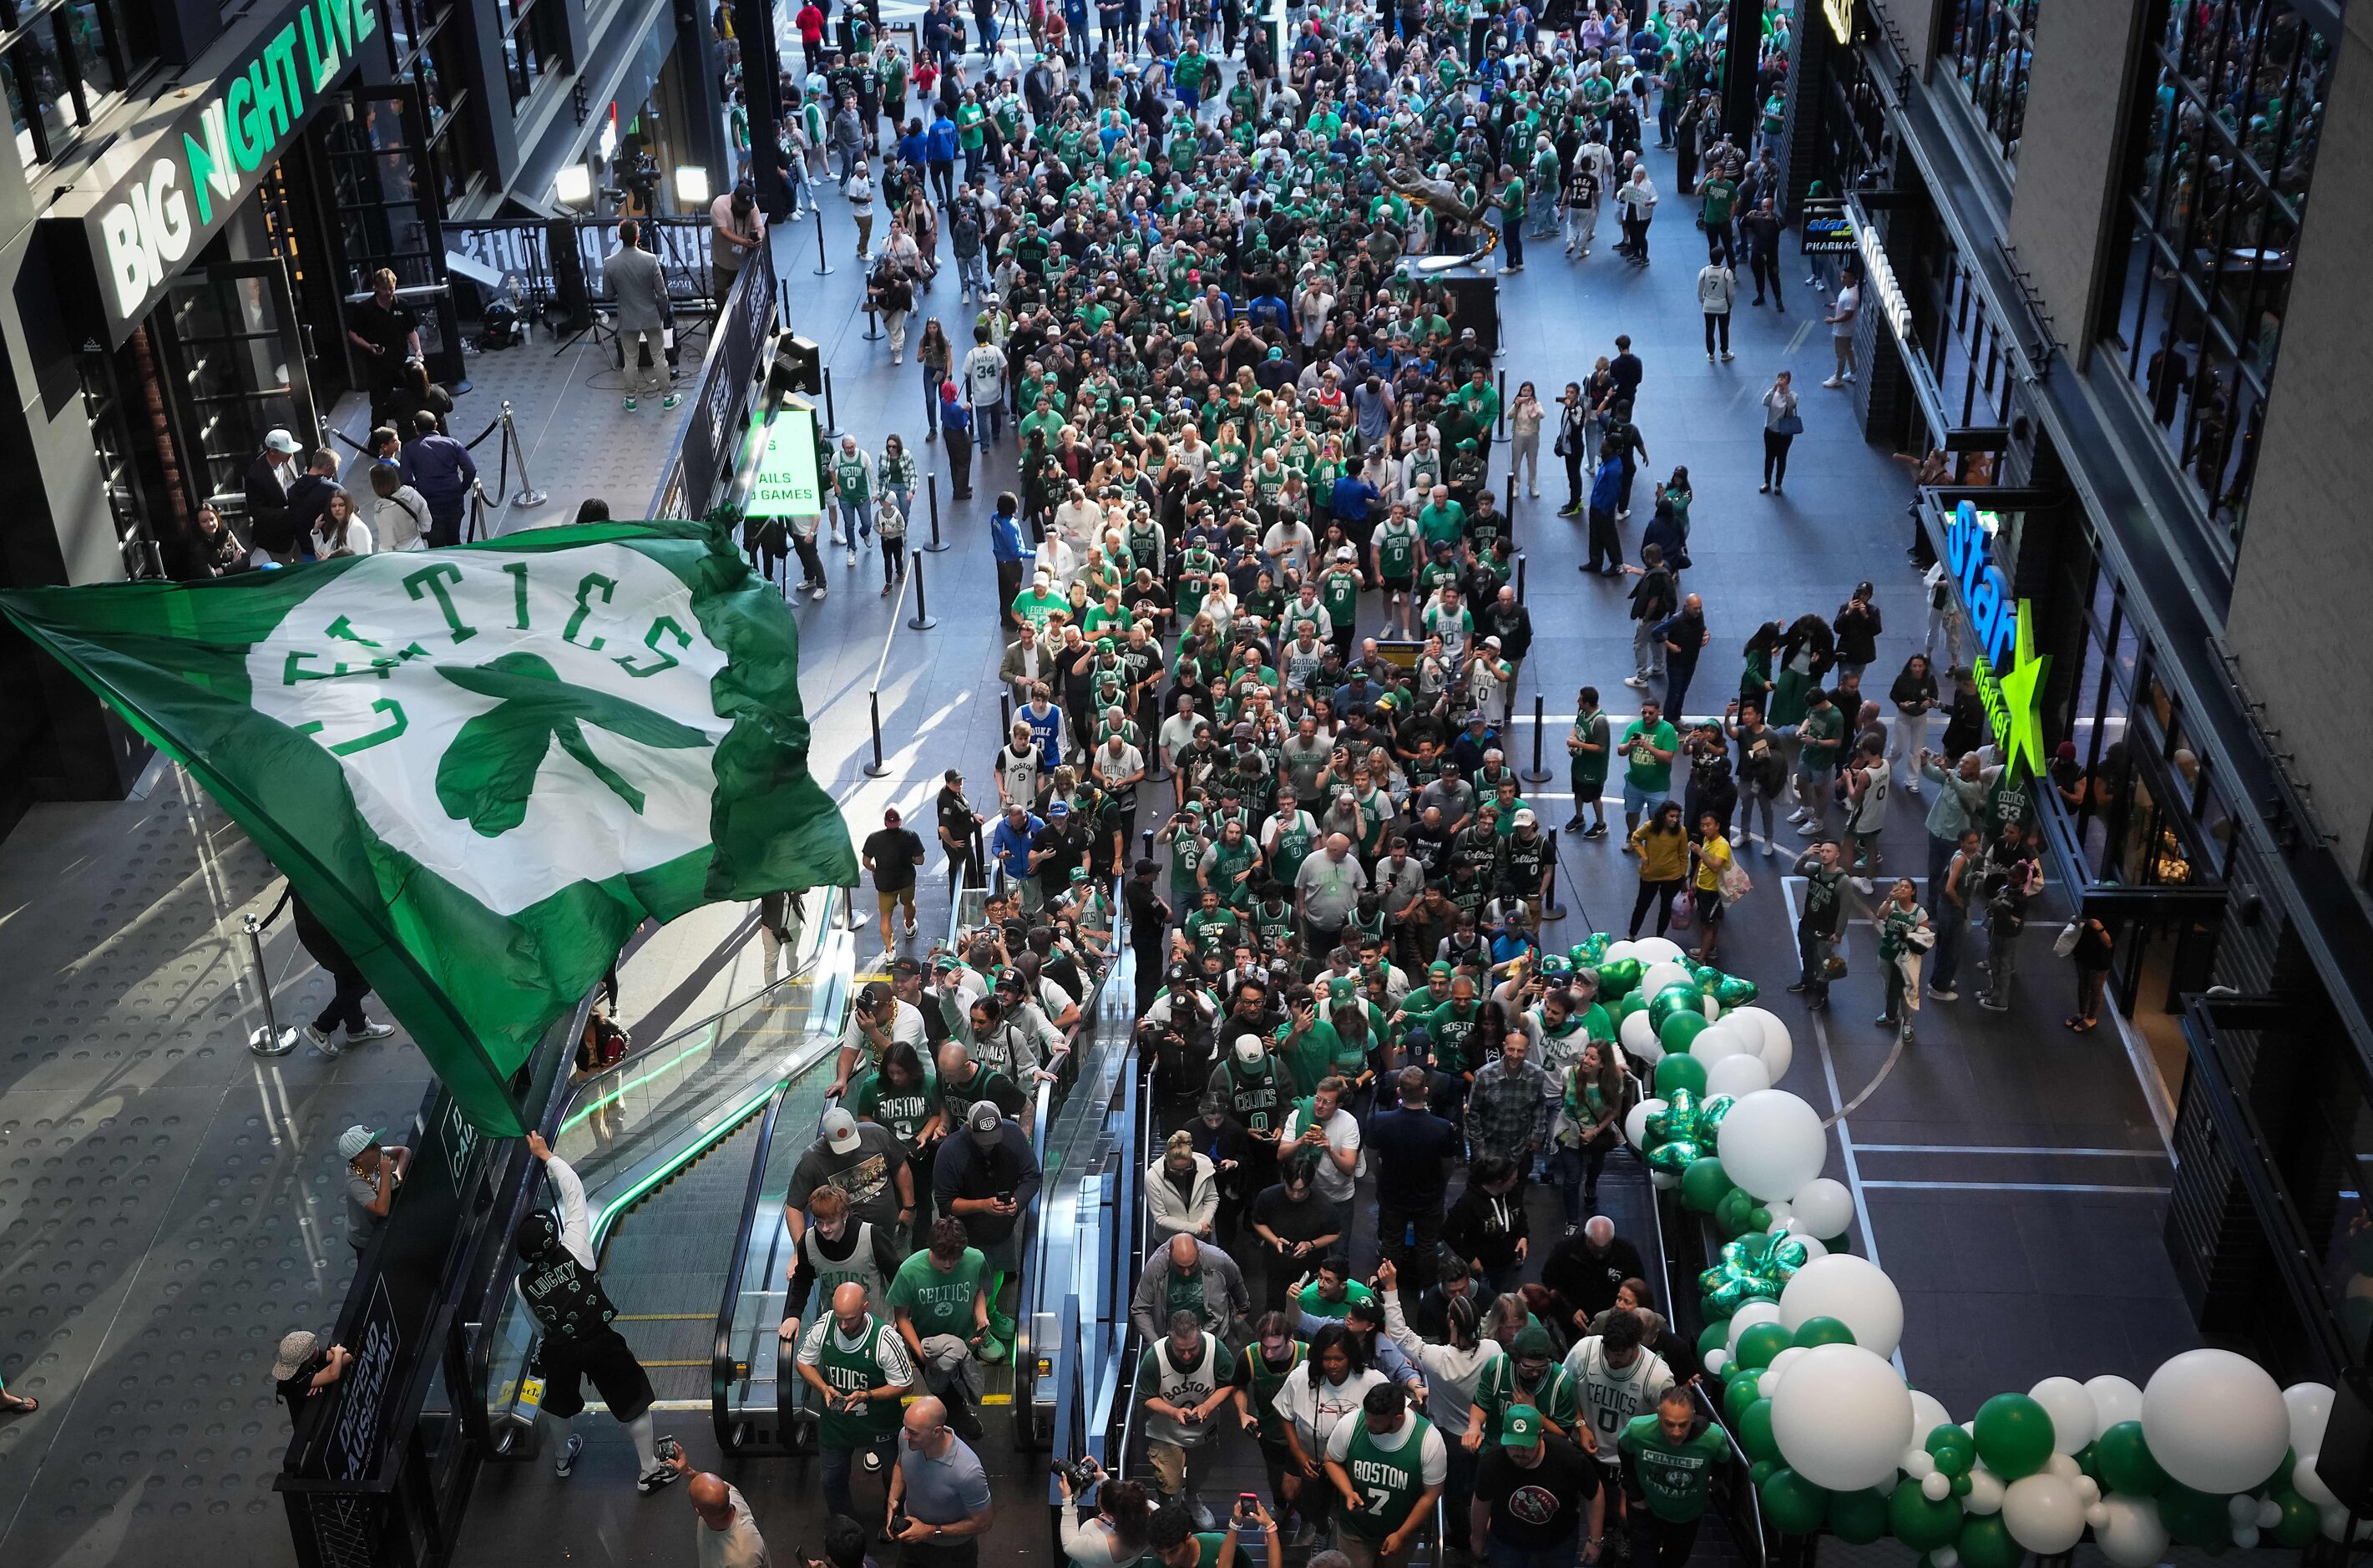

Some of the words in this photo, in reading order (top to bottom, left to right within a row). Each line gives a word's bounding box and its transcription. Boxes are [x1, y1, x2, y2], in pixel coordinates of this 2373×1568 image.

[865, 79, 874, 94] 0
[1519, 137, 1526, 148] 0
[101, 157, 192, 320] BIG
[183, 22, 305, 226] NIGHT
[300, 0, 377, 94] LIVE
[1573, 177, 1592, 187] NASH
[1265, 185, 1283, 194] BOSTON
[1572, 187, 1591, 201] 13
[1806, 218, 1846, 231] star
[1806, 241, 1859, 251] PHARMAC
[1711, 281, 1718, 291] 7
[976, 365, 995, 379] 34
[1295, 456, 1304, 469] 0
[758, 473, 791, 483] AILS
[840, 467, 862, 476] BOSTON
[847, 477, 856, 489] 0
[1261, 483, 1281, 493] CELTICS
[761, 489, 812, 500] GAMES
[1132, 539, 1155, 550] CELTICS
[1388, 536, 1411, 547] BOSTON
[1138, 549, 1149, 562] 7
[1394, 548, 1404, 561] 0
[1191, 579, 1201, 593] 0
[1332, 579, 1350, 589] BOSTON
[1948, 499, 2017, 669] star
[1335, 589, 1344, 601] 0
[1438, 620, 1461, 632] CELTICS
[1445, 632, 1455, 645] 0
[1124, 653, 1148, 667] CELTICS
[1293, 658, 1318, 666] BOSTON
[1475, 675, 1497, 687] CELTICS
[1479, 687, 1488, 701] 0
[1974, 655, 2011, 750] market
[1030, 726, 1052, 737] DUKE
[1009, 762, 1034, 773] BOSTON
[1103, 765, 1126, 777] CELTICS
[1018, 772, 1026, 781] 9
[1876, 784, 1886, 801] 0
[1998, 791, 2026, 807] CELTICS
[1997, 803, 2021, 821] 33
[1283, 836, 1308, 849] CELTICS
[1291, 847, 1302, 858] 0
[1511, 853, 1539, 864] Celtics
[1185, 853, 1197, 869] 6
[1222, 858, 1250, 874] CELTICS
[1530, 864, 1537, 876] 0
[1080, 911, 1096, 924] TICS
[1261, 924, 1288, 935] BOSTON
[1442, 1022, 1475, 1034] BOSTO
[976, 1044, 1006, 1062] FINALS
[1235, 1089, 1278, 1112] CELTICS
[879, 1096, 925, 1119] BOSTON
[981, 1119, 994, 1129] DEUS
[1251, 1111, 1268, 1131] 0
[528, 1259, 576, 1300] LUCKY
[918, 1282, 970, 1303] CELTICS
[338, 1320, 382, 1454] DEFEND
[1161, 1380, 1213, 1401] BOSTON
[342, 1320, 393, 1481] AUSEWAY
[1588, 1382, 1638, 1415] CELTICS
[1597, 1408, 1619, 1434] 0
[1644, 1449, 1694, 1468] CELTICS
[1353, 1459, 1409, 1490] BOSTON
[1367, 1487, 1390, 1516] 7
